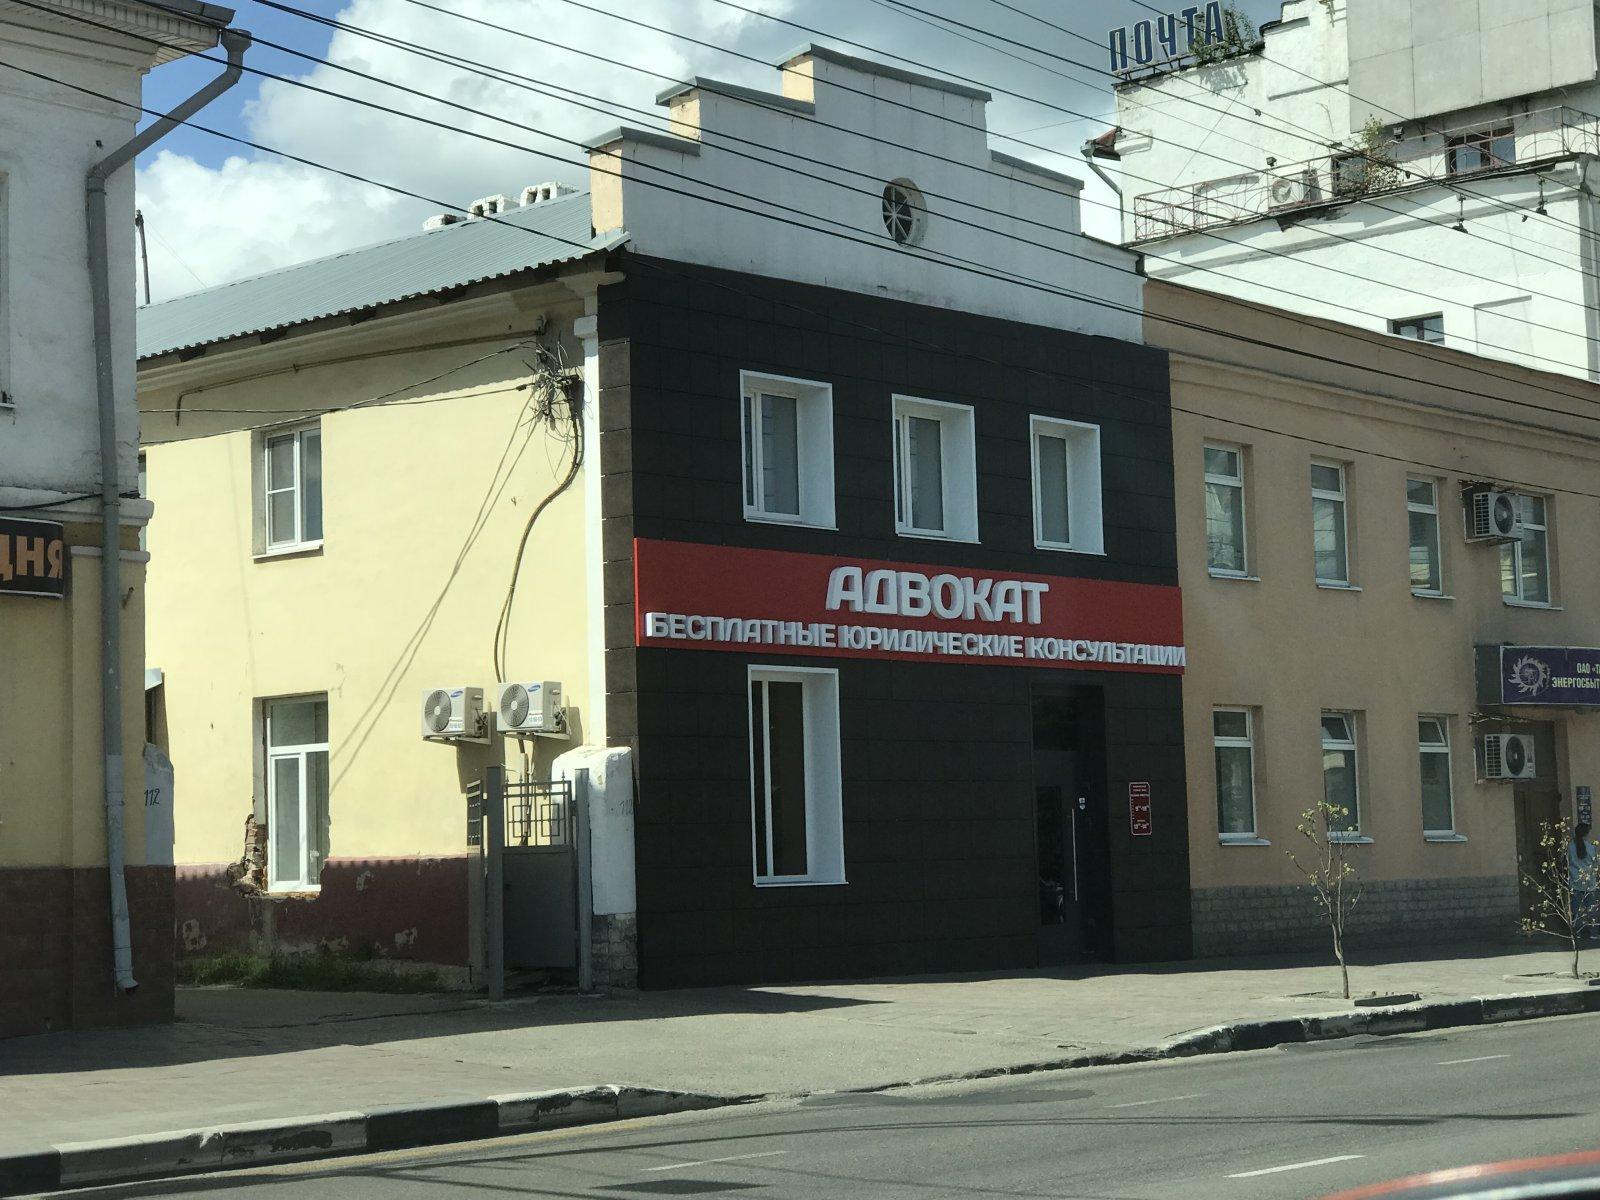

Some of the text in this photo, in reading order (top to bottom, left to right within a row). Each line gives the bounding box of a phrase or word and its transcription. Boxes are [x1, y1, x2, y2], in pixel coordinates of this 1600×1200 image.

[1108, 0, 1225, 72] ПОЧТА
[825, 566, 1049, 625] АДВОКАТ
[645, 612, 1186, 667] БЕСПЛАТНЫЕ ЮРИДИЧЕСКИЕ КОНСУЛЬТАЦИИ
[1551, 676, 1600, 689] ЭНЕРГОСБЫТ
[1576, 662, 1600, 675] ОАО «Т
[144, 788, 160, 806] 112
